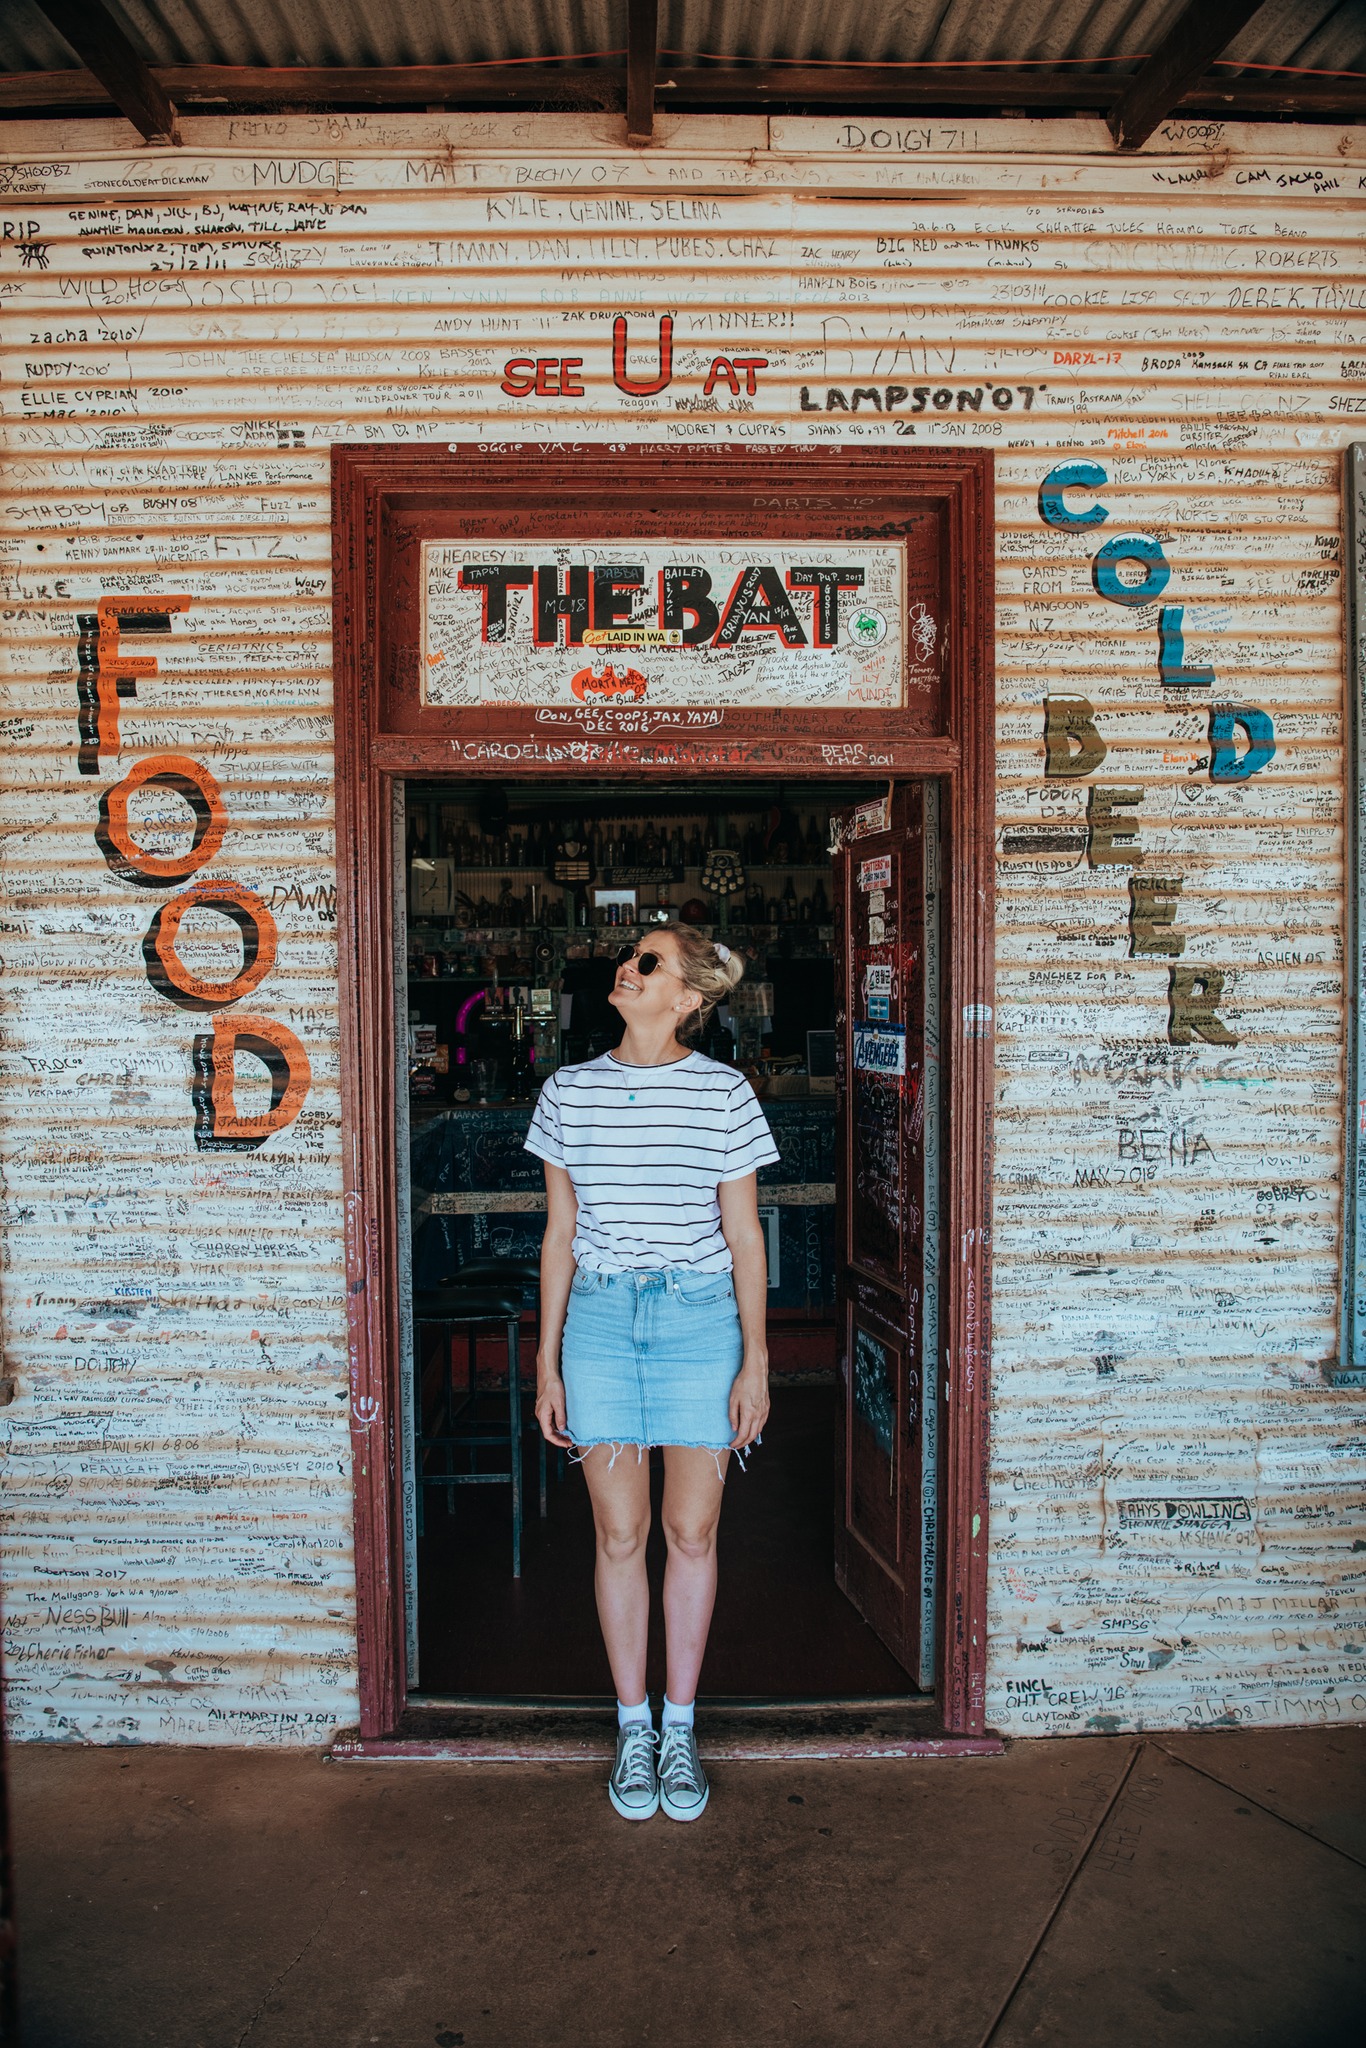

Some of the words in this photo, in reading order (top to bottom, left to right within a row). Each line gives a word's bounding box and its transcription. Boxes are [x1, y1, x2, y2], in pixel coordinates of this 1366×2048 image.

[253, 160, 354, 186] MUDGE
[405, 161, 482, 183] MATT
[1235, 169, 1271, 185] CAM
[1276, 170, 1324, 188] JACKO
[1313, 178, 1340, 194] PHIL
[3, 221, 40, 240] RIP
[877, 237, 905, 253] BIG
[913, 239, 938, 253] RED
[985, 238, 1040, 252] TRUNKS
[801, 247, 821, 259] ZAC
[59, 277, 117, 296] WILD
[562, 311, 586, 321] ZAK
[434, 317, 472, 331] ANDY
[481, 318, 521, 331] HUNT
[30, 329, 89, 344] zacha
[501, 358, 585, 397] SEE
[612, 315, 673, 397] U
[703, 356, 769, 396] AT
[629, 355, 658, 365] GREG
[21, 393, 68, 406] ELLIE
[74, 390, 138, 402] CYPRIAN
[244, 421, 281, 431] NIKKI
[312, 424, 357, 438] AZZA
[364, 426, 386, 439] BM
[972, 422, 1003, 436] 2008
[244, 432, 276, 440] ADAM
[143, 498, 178, 510] BUSHY
[180, 498, 198, 509] 08
[66, 549, 100, 561] KENNY
[583, 549, 651, 565] DAZZA
[428, 567, 455, 579] MIKE
[664, 567, 704, 579] BAILEY
[795, 572, 814, 583] DAY
[1023, 581, 1063, 595] FROM
[458, 565, 644, 647] THE
[658, 566, 865, 648] BAT
[1039, 458, 1278, 783] COLD
[585, 630, 608, 644] Get
[608, 632, 631, 642] LAID
[634, 632, 645, 642] IN
[647, 632, 665, 642] WA
[198, 642, 284, 653] GERIATRICS
[586, 720, 613, 731] DEC
[619, 720, 650, 732] 2016
[822, 744, 868, 757] BEAR
[1003, 860, 1034, 871] RUSTY
[1043, 693, 1236, 1046] BEER
[79, 595, 311, 1151] FOOD
[290, 930, 324, 939] IVAN
[1257, 951, 1301, 966] ASHEN
[1028, 971, 1082, 981] SANCHEZ
[95, 1568, 128, 1580] 2017
[1048, 1689, 1099, 1707] CREW
